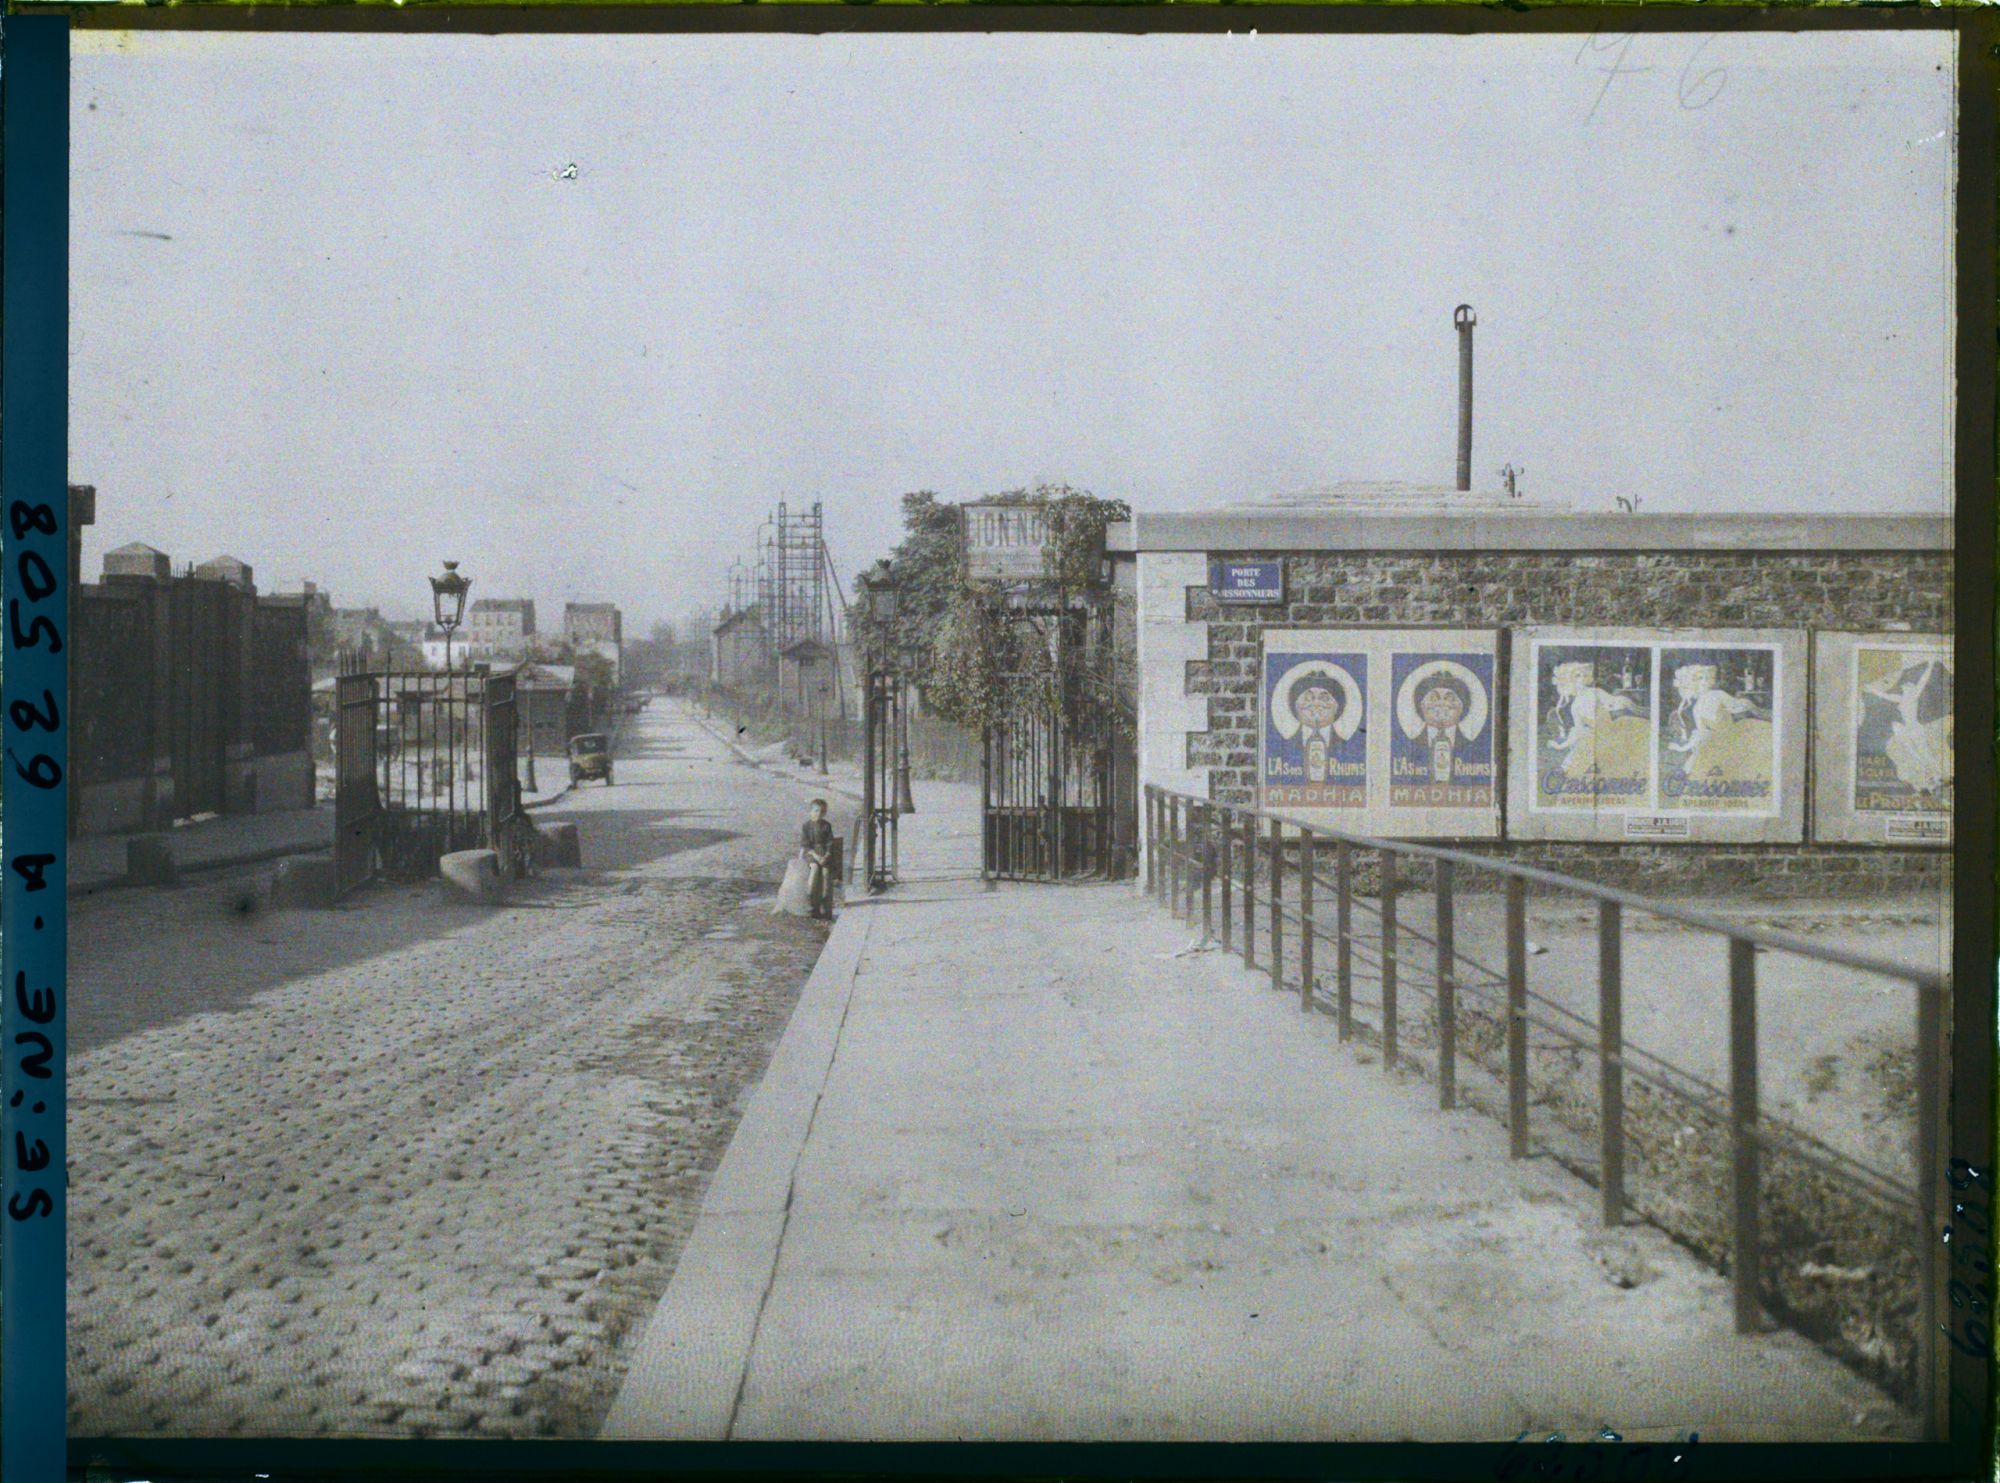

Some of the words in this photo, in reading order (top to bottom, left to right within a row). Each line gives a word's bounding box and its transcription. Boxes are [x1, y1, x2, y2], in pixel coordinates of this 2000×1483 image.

[1231, 567, 1261, 577] PORTE
[1237, 578, 1256, 587] DES
[1269, 788, 1363, 802] MADHIA
[1394, 788, 1489, 802] MADHIA
[12, 853, 57, 893] A
